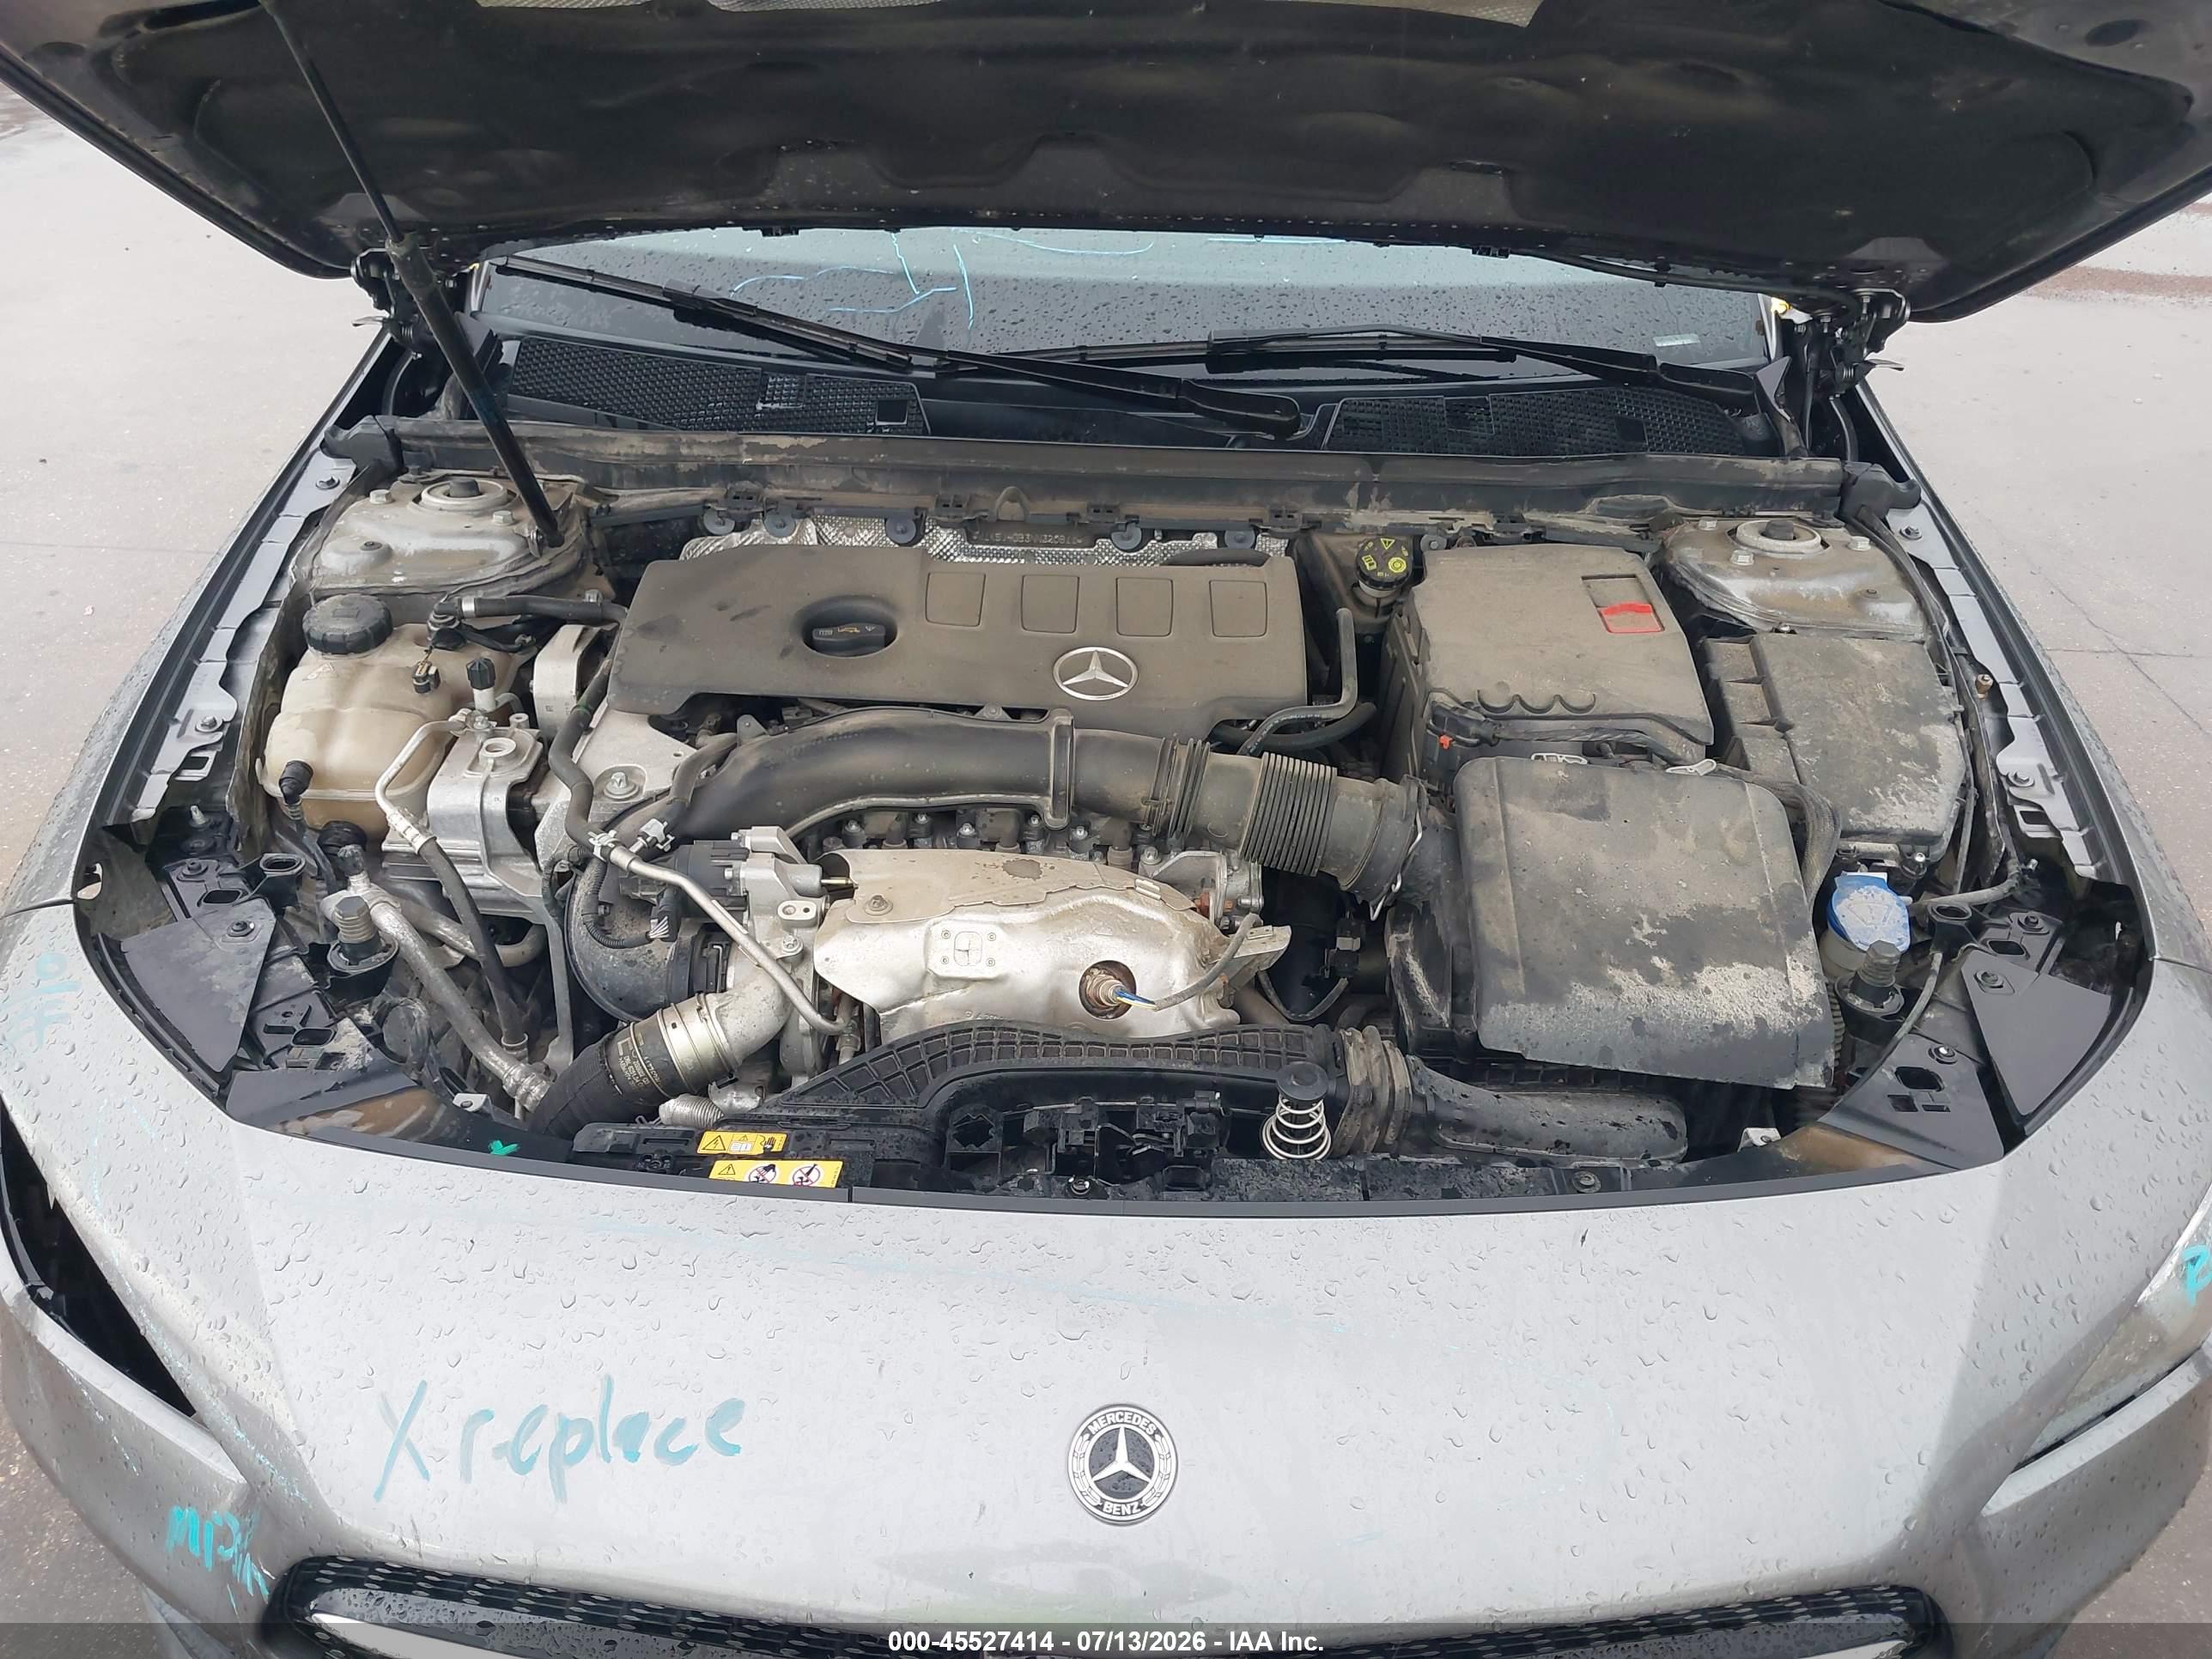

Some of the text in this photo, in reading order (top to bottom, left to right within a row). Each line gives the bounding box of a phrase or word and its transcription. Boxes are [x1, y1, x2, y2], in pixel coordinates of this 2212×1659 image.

[1087, 1411, 1157, 1435] MERCEDES
[459, 1374, 746, 1504] replace
[1103, 1502, 1141, 1516] BENZ
